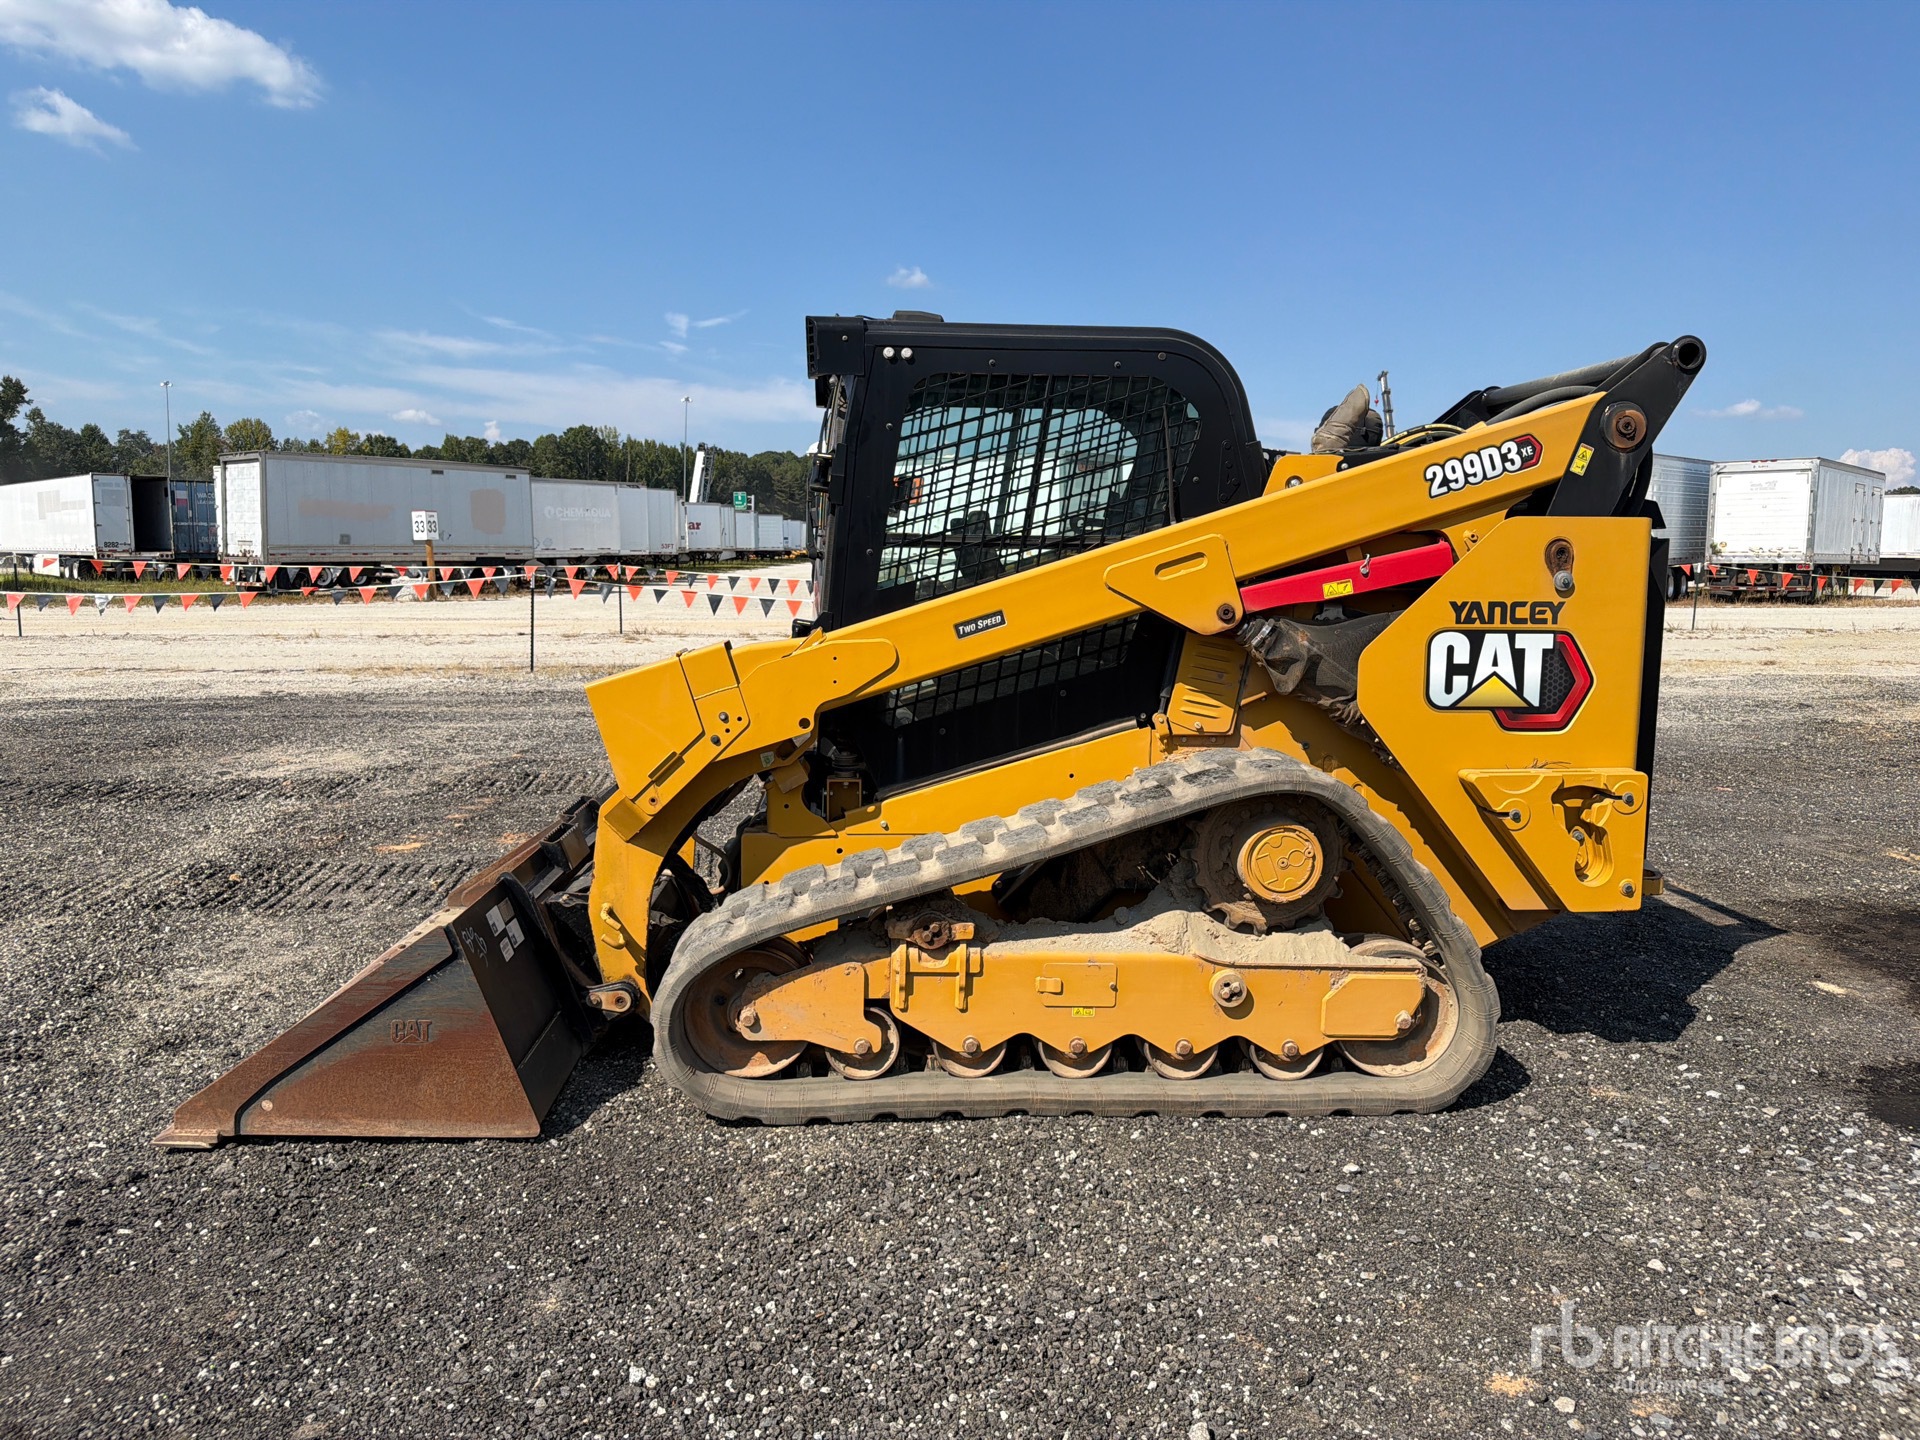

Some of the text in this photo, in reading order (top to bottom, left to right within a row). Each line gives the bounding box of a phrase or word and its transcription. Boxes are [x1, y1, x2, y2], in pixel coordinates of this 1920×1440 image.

[1520, 445, 1534, 458] XE
[1425, 440, 1522, 497] 299D3
[414, 520, 425, 533] 33
[427, 520, 437, 533] 33
[1449, 601, 1566, 625] YANCEY
[1429, 631, 1554, 707] CAT
[391, 1020, 432, 1042] CAT
